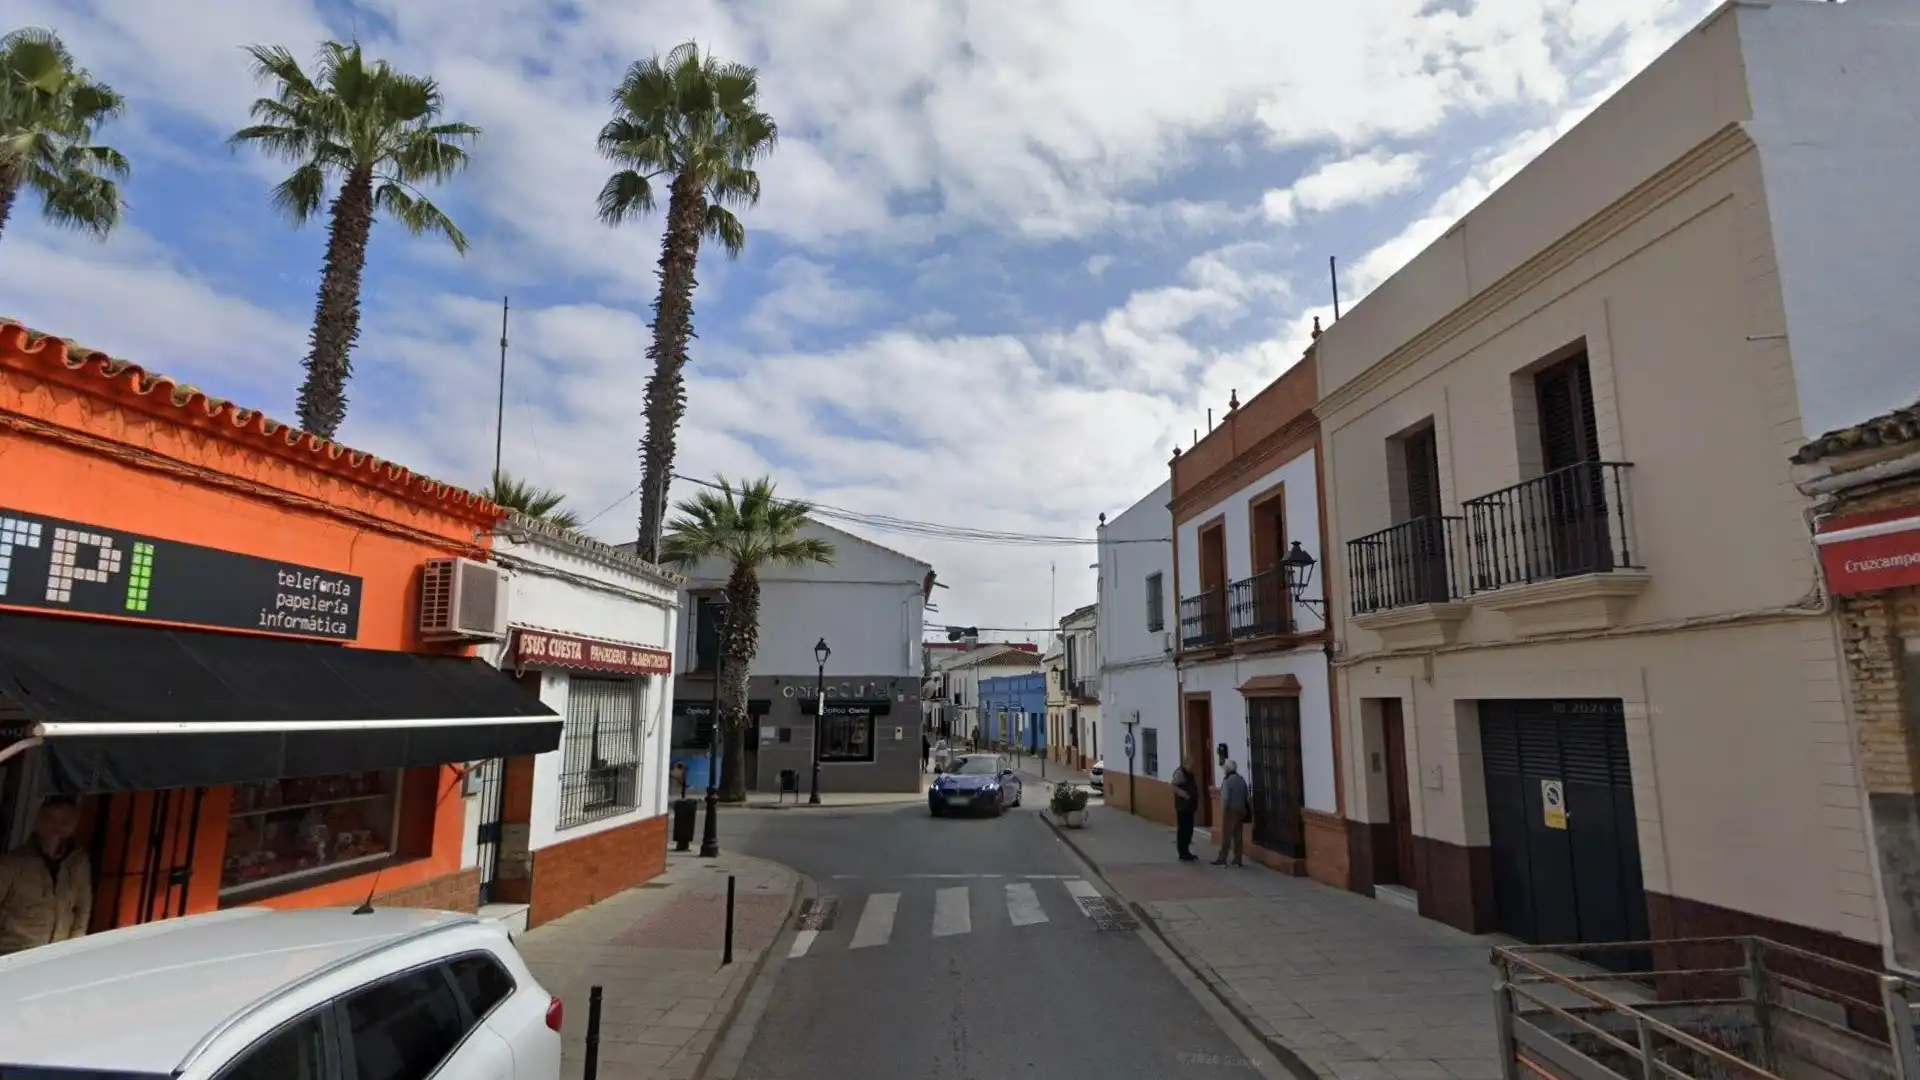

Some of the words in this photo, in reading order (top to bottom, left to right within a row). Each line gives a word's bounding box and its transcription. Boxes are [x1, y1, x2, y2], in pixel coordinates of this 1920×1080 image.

[1844, 552, 1920, 573] Cruzcampo
[277, 568, 351, 597] telefonía
[275, 592, 349, 615] papelería
[258, 608, 347, 634] informática
[548, 637, 582, 660] CUESTA
